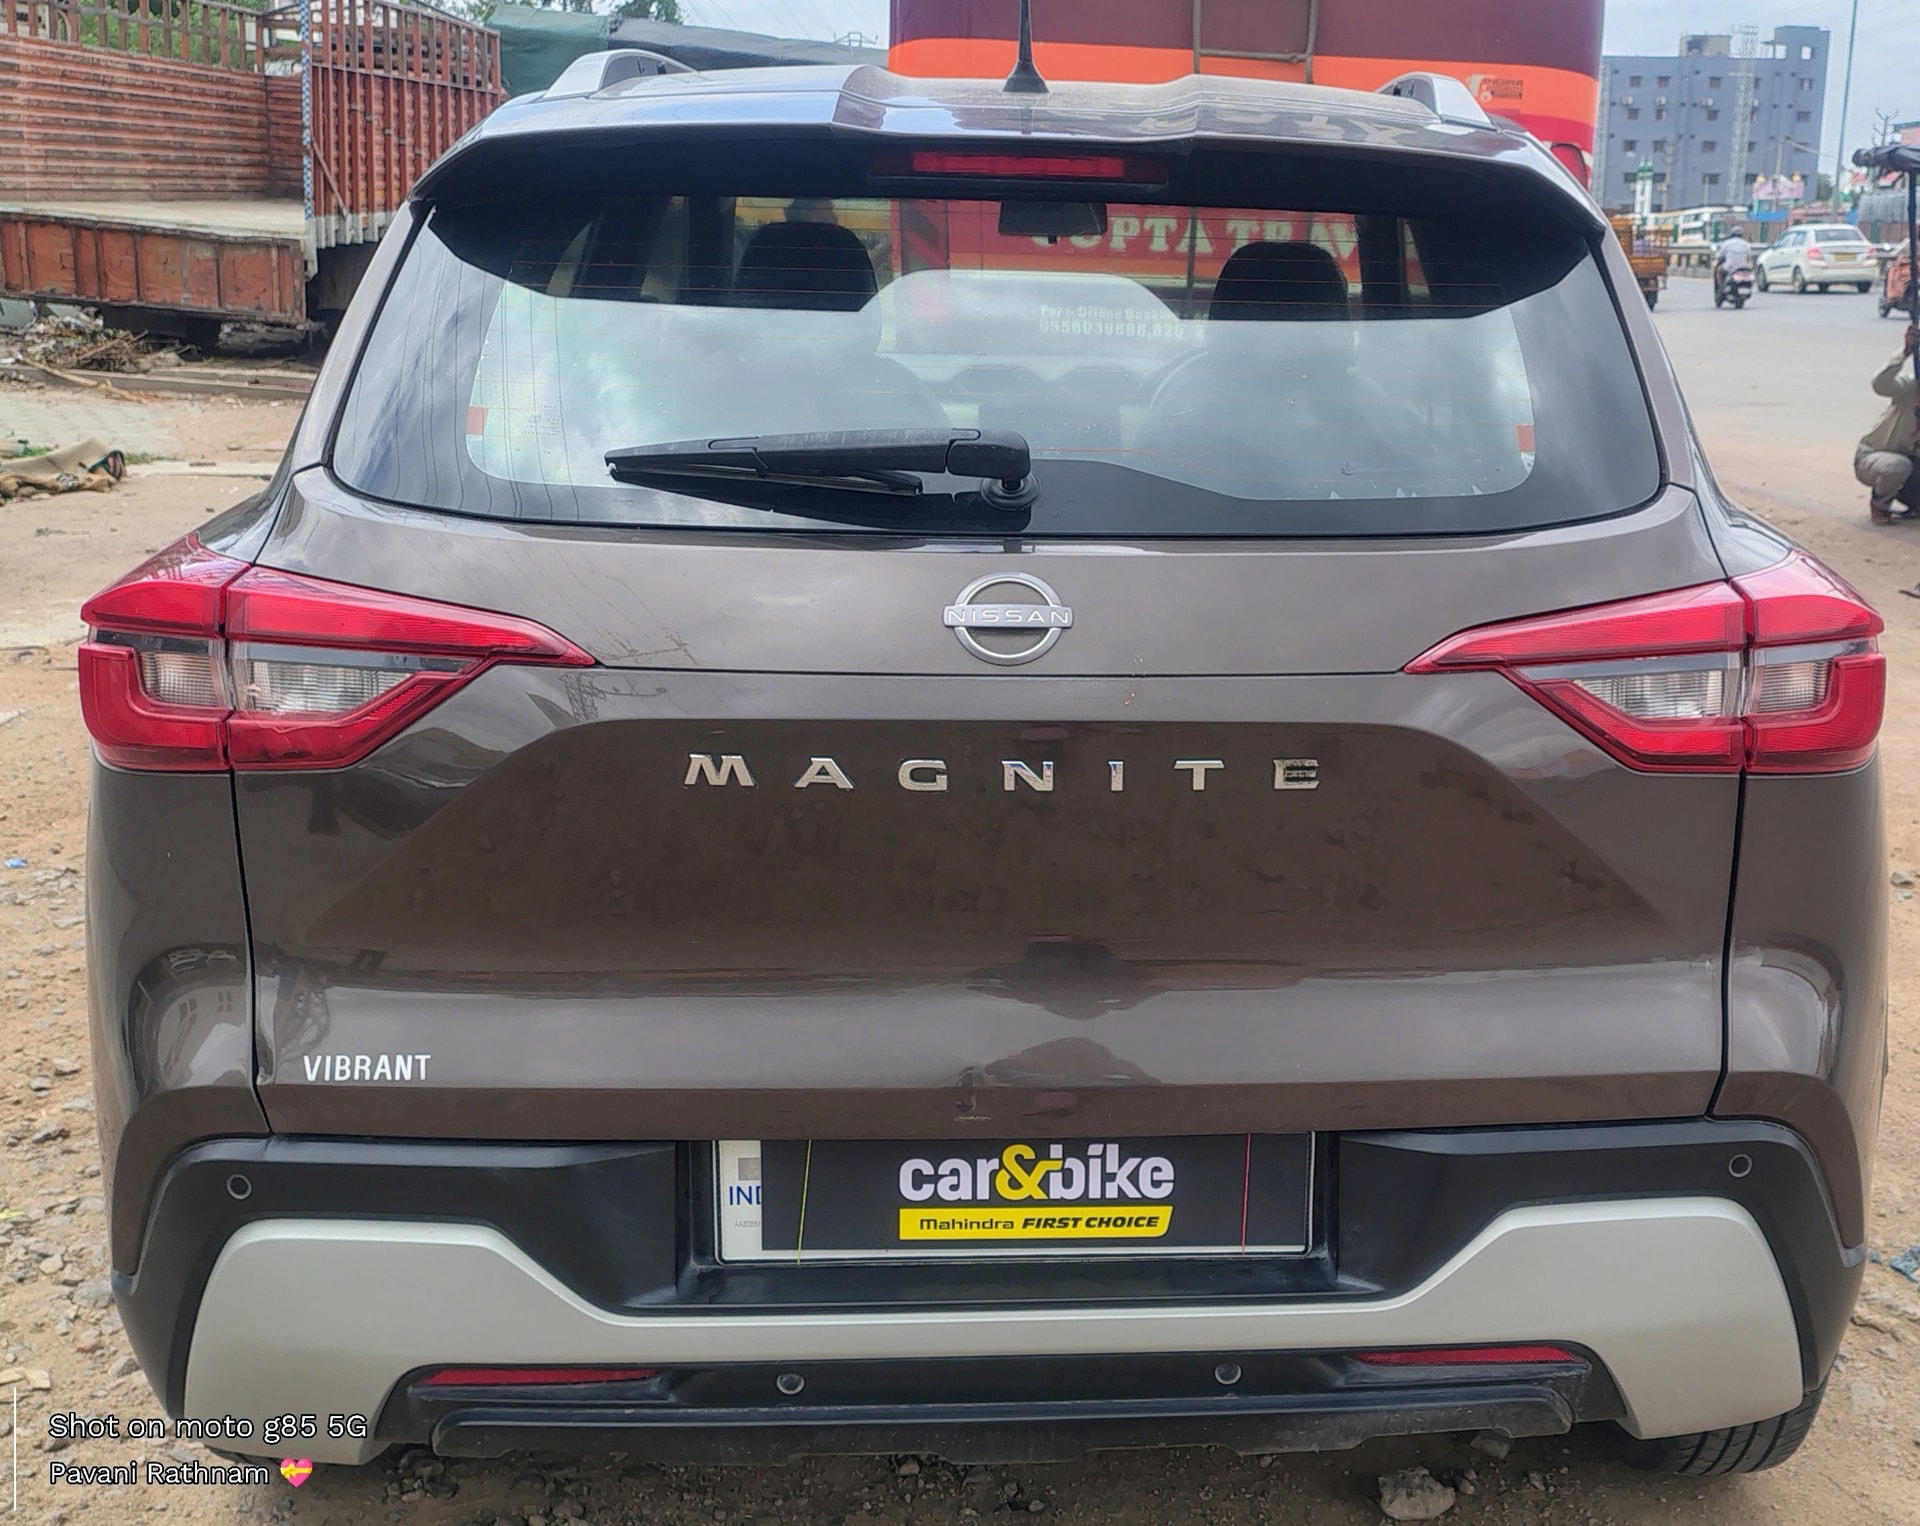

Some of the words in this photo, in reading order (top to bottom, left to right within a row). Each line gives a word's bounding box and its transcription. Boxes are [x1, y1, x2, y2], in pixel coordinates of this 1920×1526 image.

[1032, 216, 1213, 252] PTA
[947, 608, 1070, 623] NISSAN
[682, 753, 1321, 793] MAGNITE
[303, 1054, 432, 1082] VIBRANT
[899, 1143, 1175, 1201] car&bike
[919, 1218, 1015, 1230] Mahindra
[1021, 1217, 1083, 1229] FIRST
[1085, 1216, 1160, 1228] CHOICE
